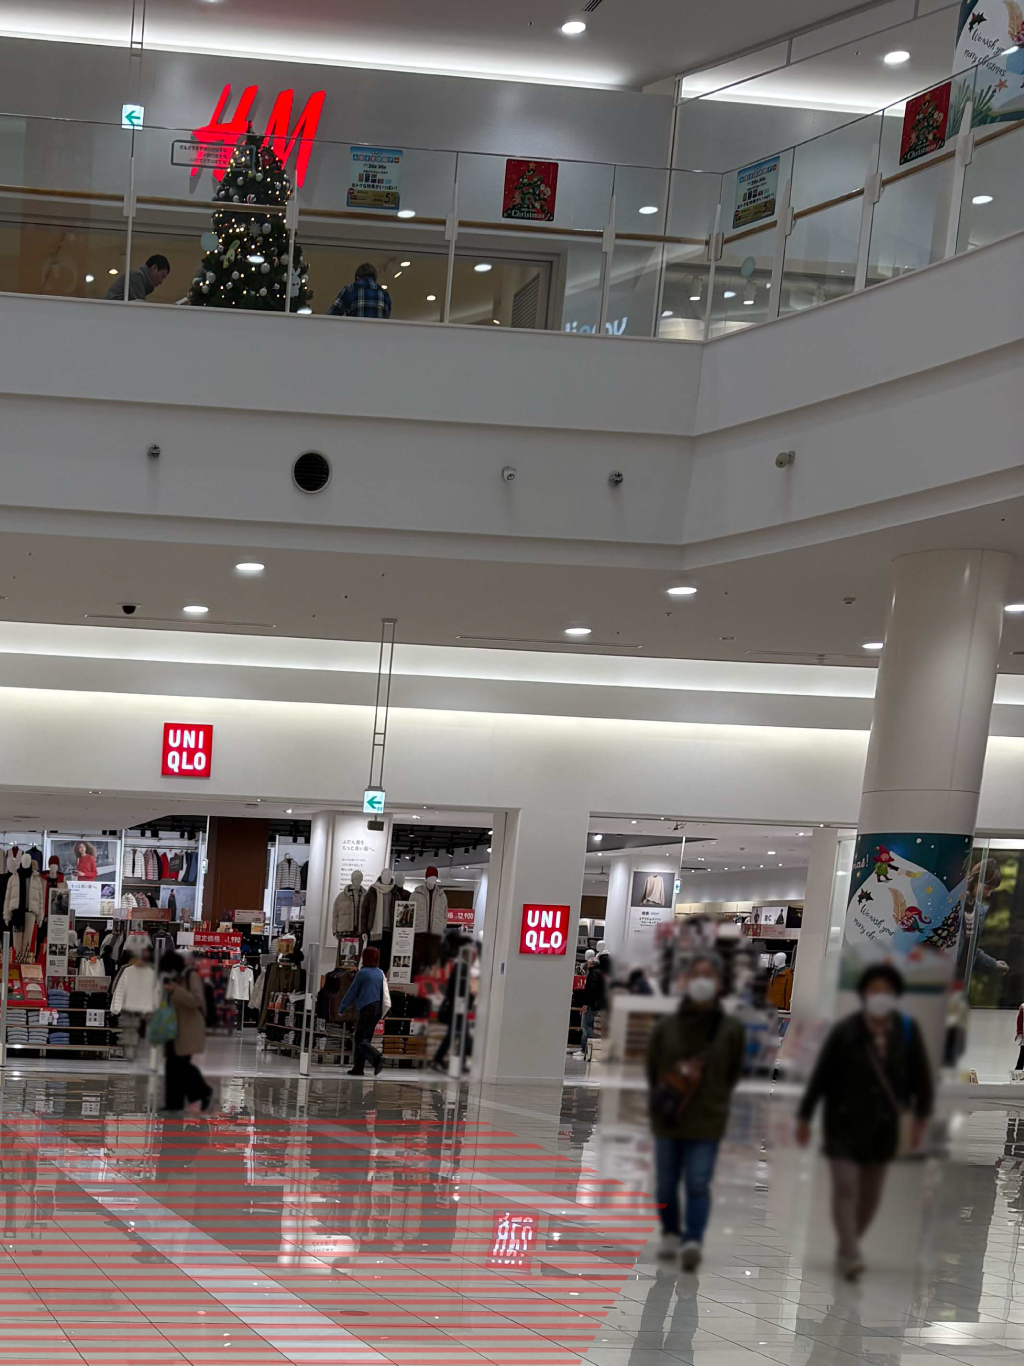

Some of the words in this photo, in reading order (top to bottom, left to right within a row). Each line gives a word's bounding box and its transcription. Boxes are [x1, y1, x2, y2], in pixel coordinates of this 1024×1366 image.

[511, 209, 545, 219] Christmas
[168, 729, 204, 749] UNI
[167, 750, 207, 773] QLO
[527, 910, 562, 929] UNI
[525, 930, 563, 951] QLO
